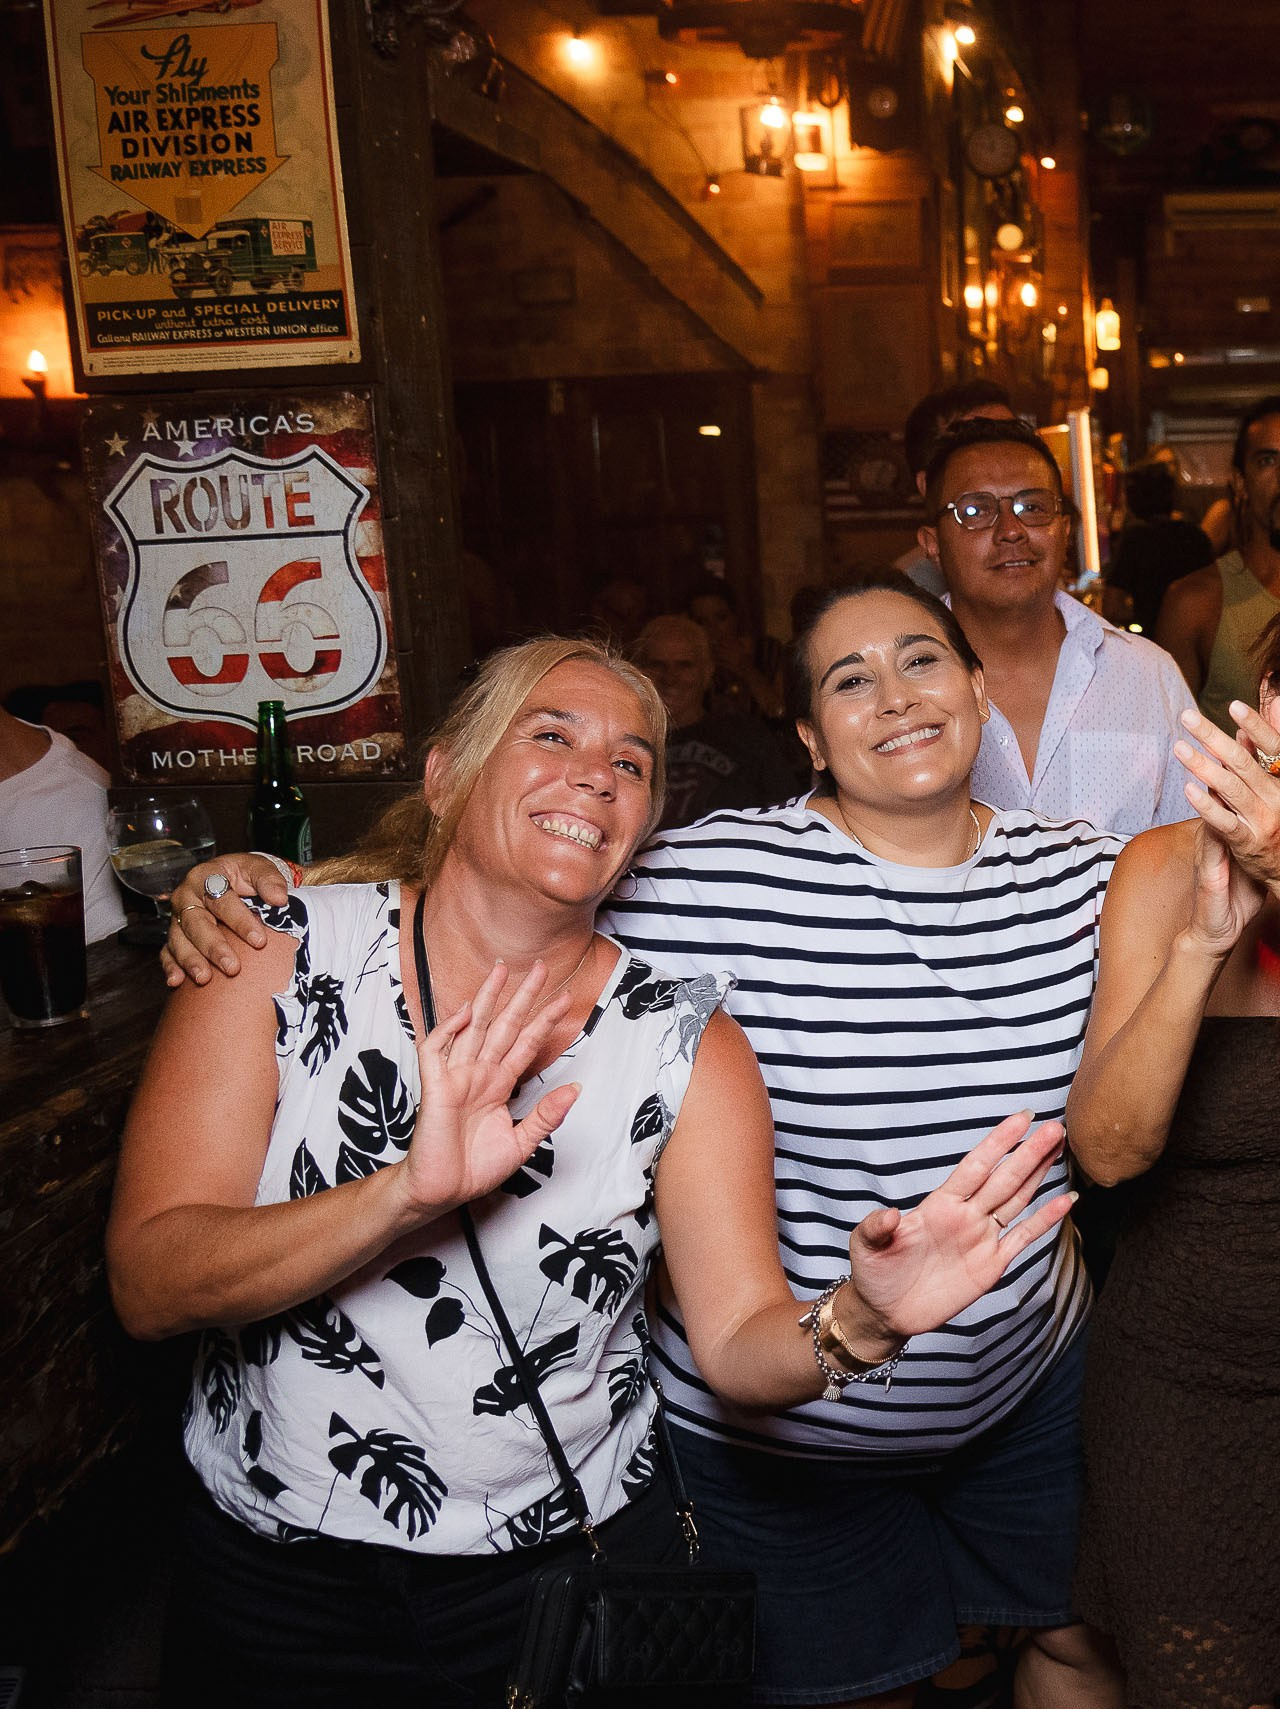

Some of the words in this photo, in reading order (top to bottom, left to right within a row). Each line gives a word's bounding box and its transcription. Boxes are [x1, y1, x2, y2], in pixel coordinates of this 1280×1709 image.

[140, 33, 209, 86] Fly
[104, 85, 150, 106] Your
[156, 78, 260, 106] Shipments
[108, 109, 150, 134] AIR
[157, 103, 261, 132] EXPRESS
[121, 132, 253, 159] DIVISION
[110, 161, 182, 182] RAILWAY
[188, 157, 267, 177] EXPRESS
[97, 308, 157, 321] PICK-UP
[161, 307, 186, 318] and
[194, 303, 260, 317] SPECIAL
[267, 298, 339, 313] DELIVERY
[155, 318, 196, 329] without
[202, 316, 235, 327] extra
[240, 314, 269, 325] cost
[132, 330, 170, 342] RAILWAY
[172, 328, 212, 340] EXPRESS
[225, 325, 270, 337] WESTERN
[273, 324, 307, 335] UNION
[310, 323, 339, 333] office
[142, 411, 316, 443] AMERICA'S
[149, 471, 316, 535] ROUTE
[162, 556, 343, 698] 66
[152, 746, 257, 770] MOTHE
[297, 741, 382, 765] ROAD
